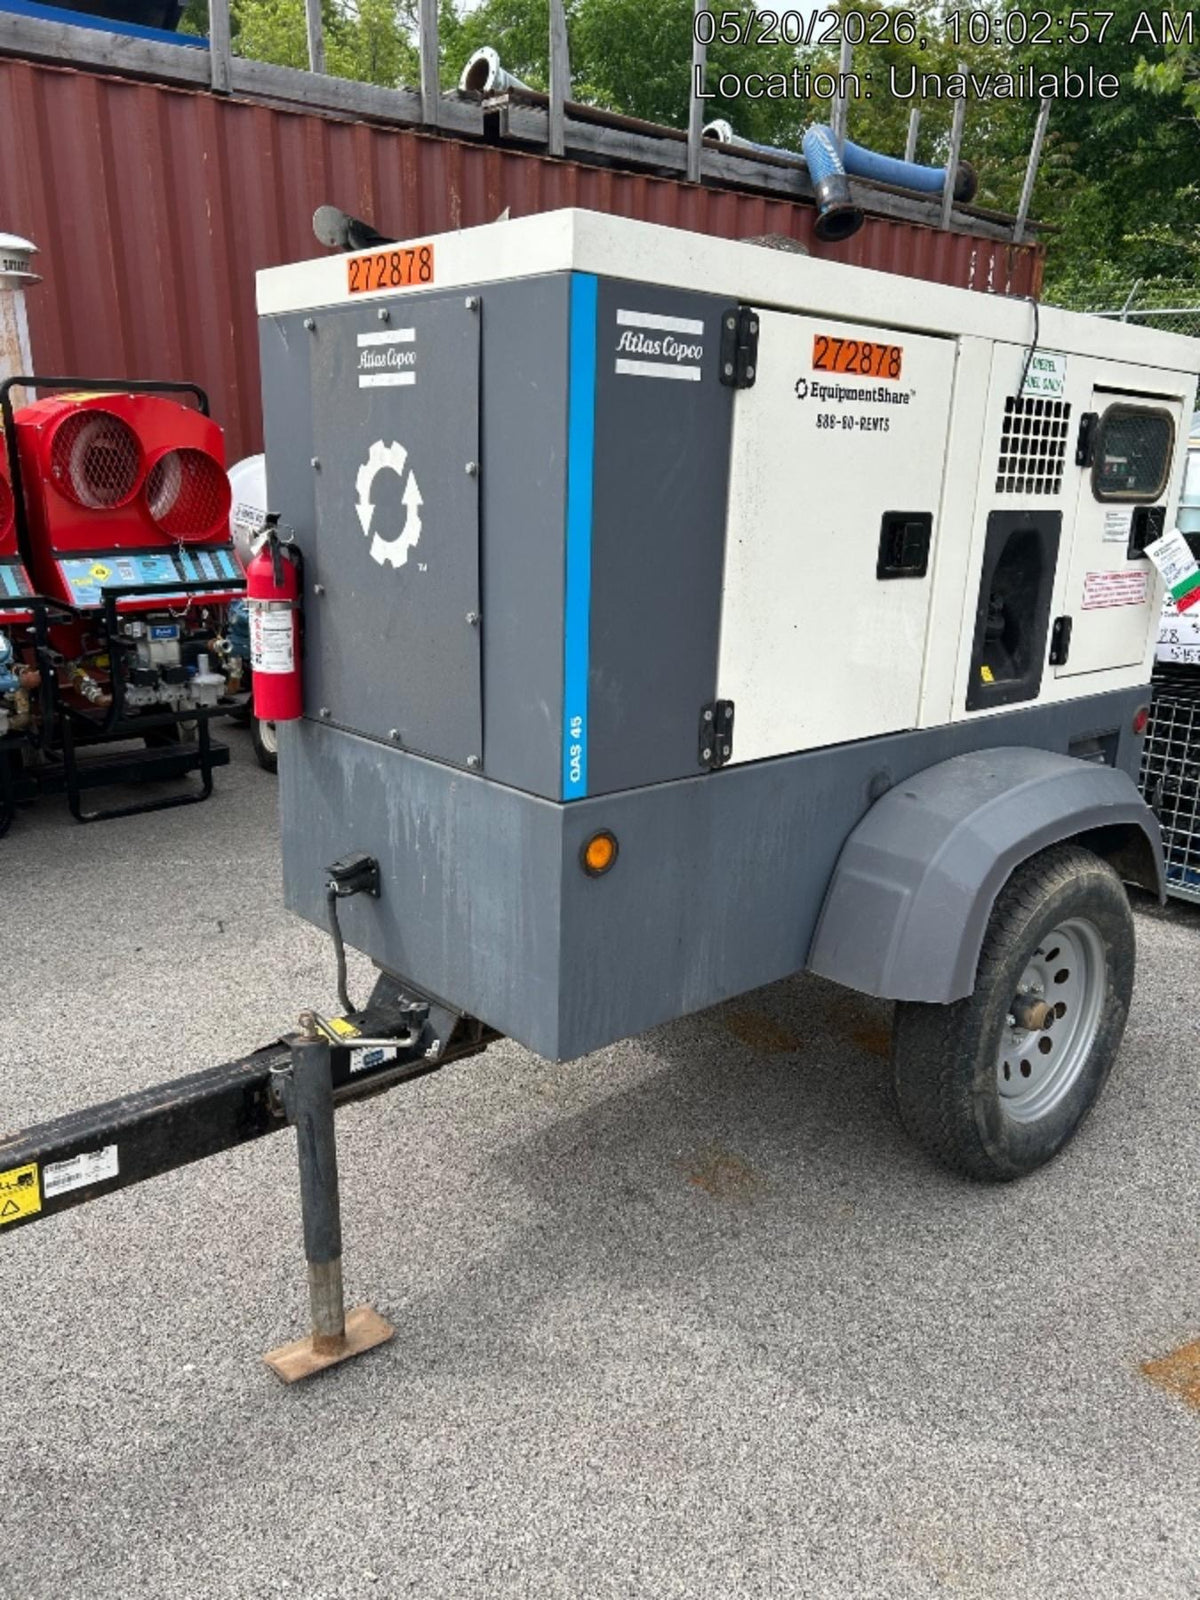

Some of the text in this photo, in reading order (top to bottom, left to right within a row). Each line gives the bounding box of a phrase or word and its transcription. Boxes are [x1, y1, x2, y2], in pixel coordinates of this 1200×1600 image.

[350, 247, 431, 292] 272878
[357, 348, 417, 369] Atlas Copco
[615, 330, 703, 362] Atlas Copco
[813, 336, 901, 378] 272878
[570, 716, 582, 783] QAS 45
